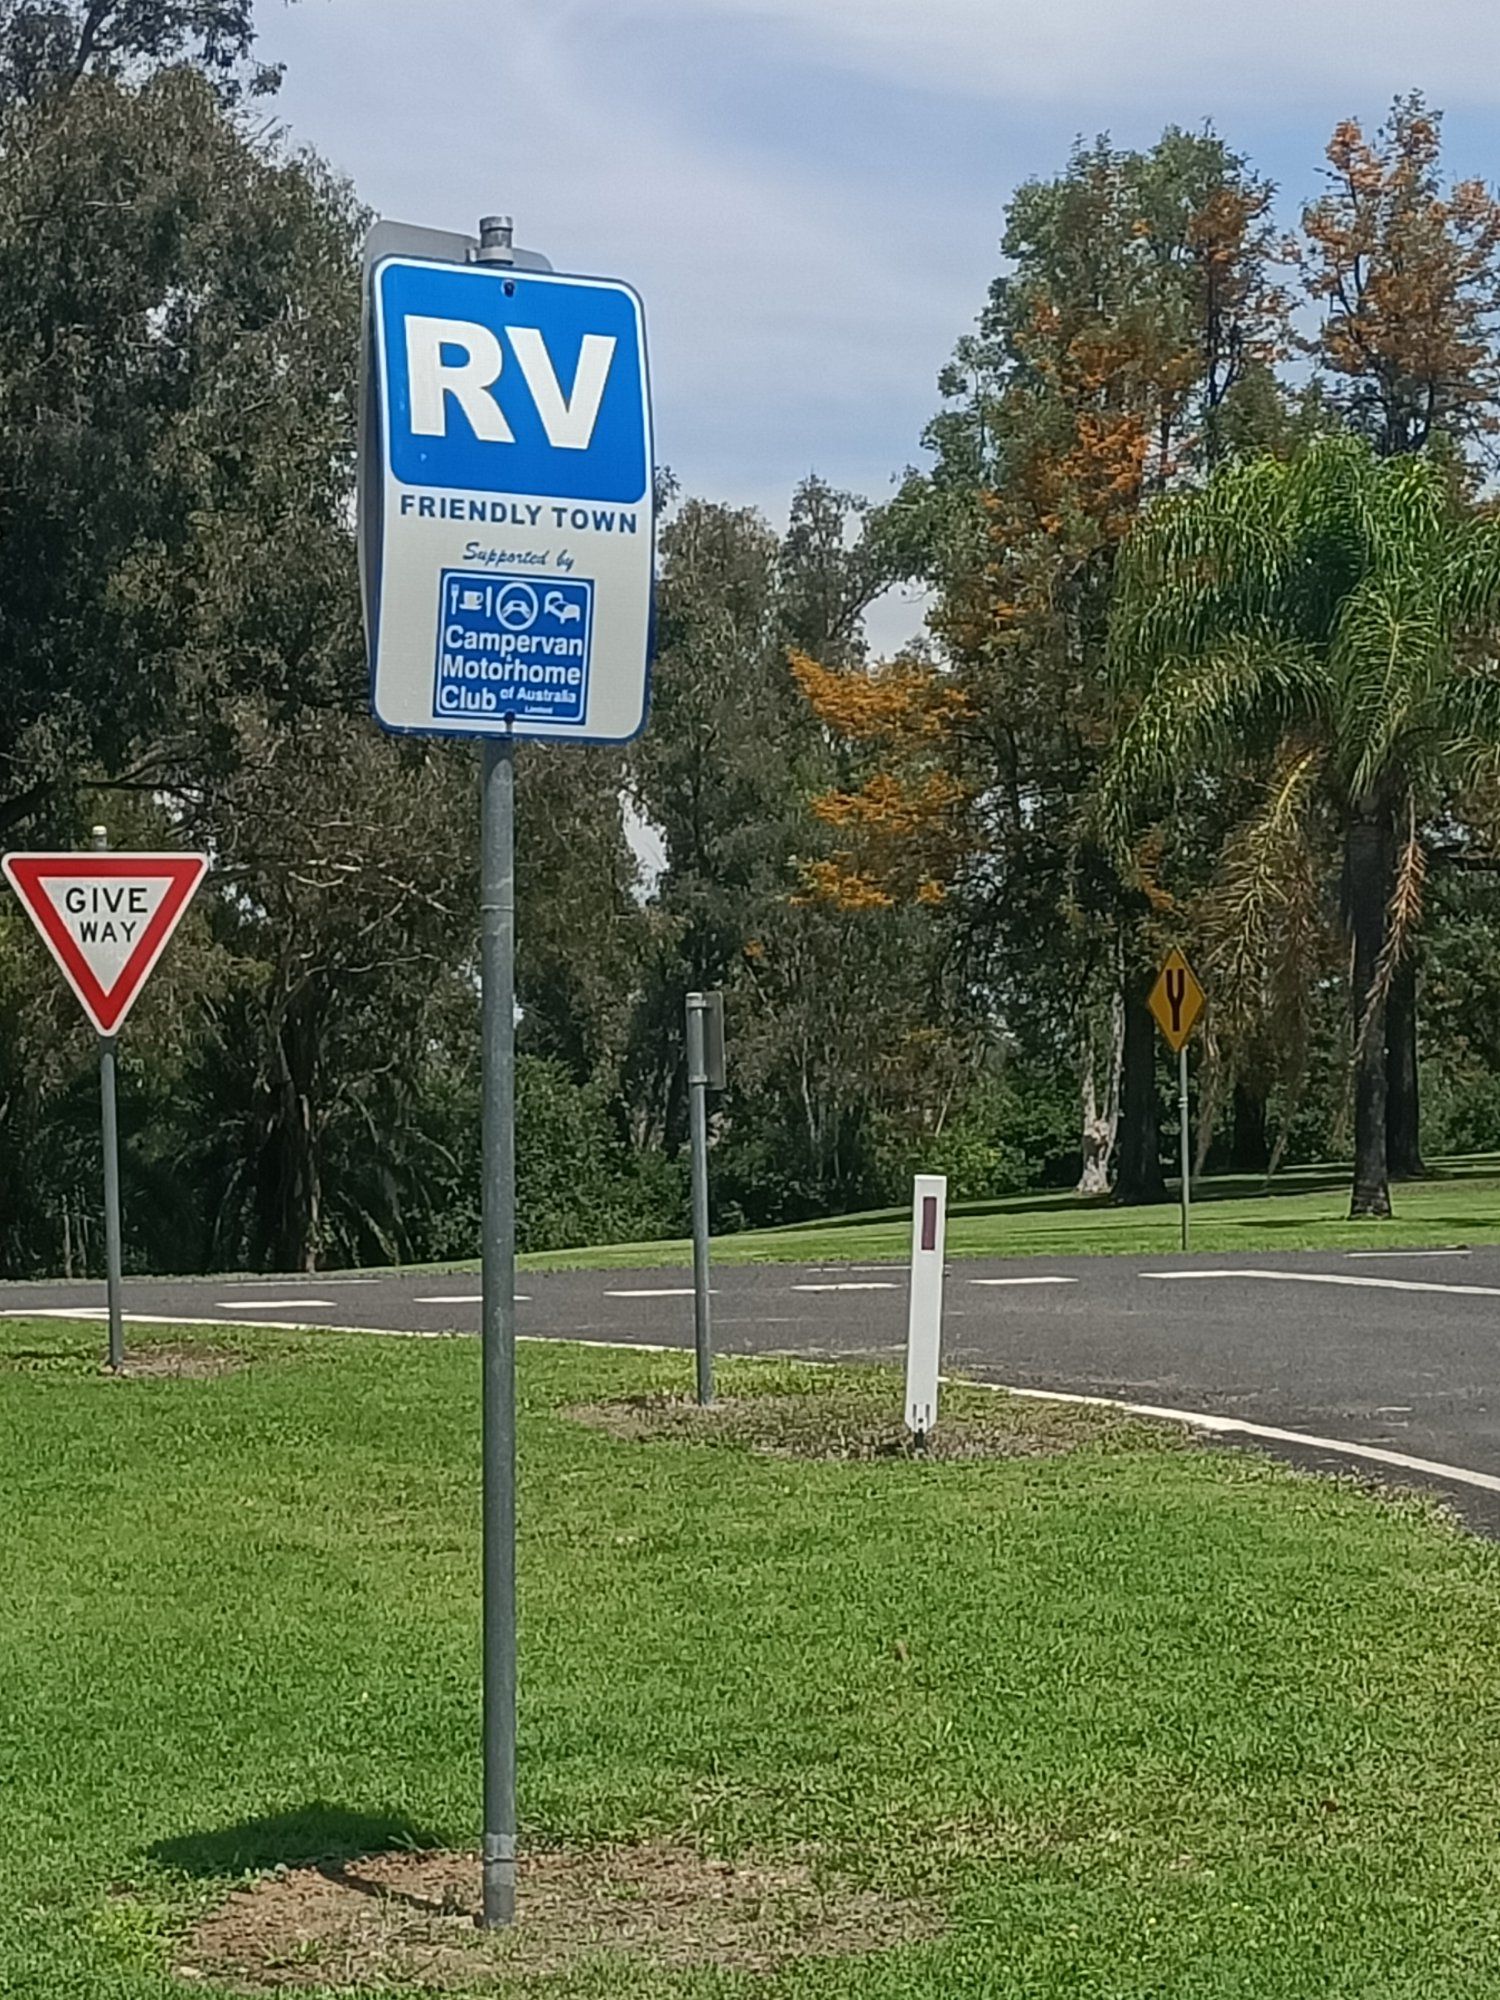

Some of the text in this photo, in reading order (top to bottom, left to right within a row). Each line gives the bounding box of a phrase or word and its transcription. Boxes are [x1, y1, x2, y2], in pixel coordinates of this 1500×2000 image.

[404, 314, 617, 450] RV
[401, 494, 637, 534] FRIENDLY TOWN
[462, 542, 575, 572] Supported by
[446, 625, 583, 658] Campervan
[443, 654, 581, 685] Motorhome
[441, 685, 577, 711] Club of Australia
[66, 887, 148, 914] GIVE
[80, 921, 137, 943] WAY
